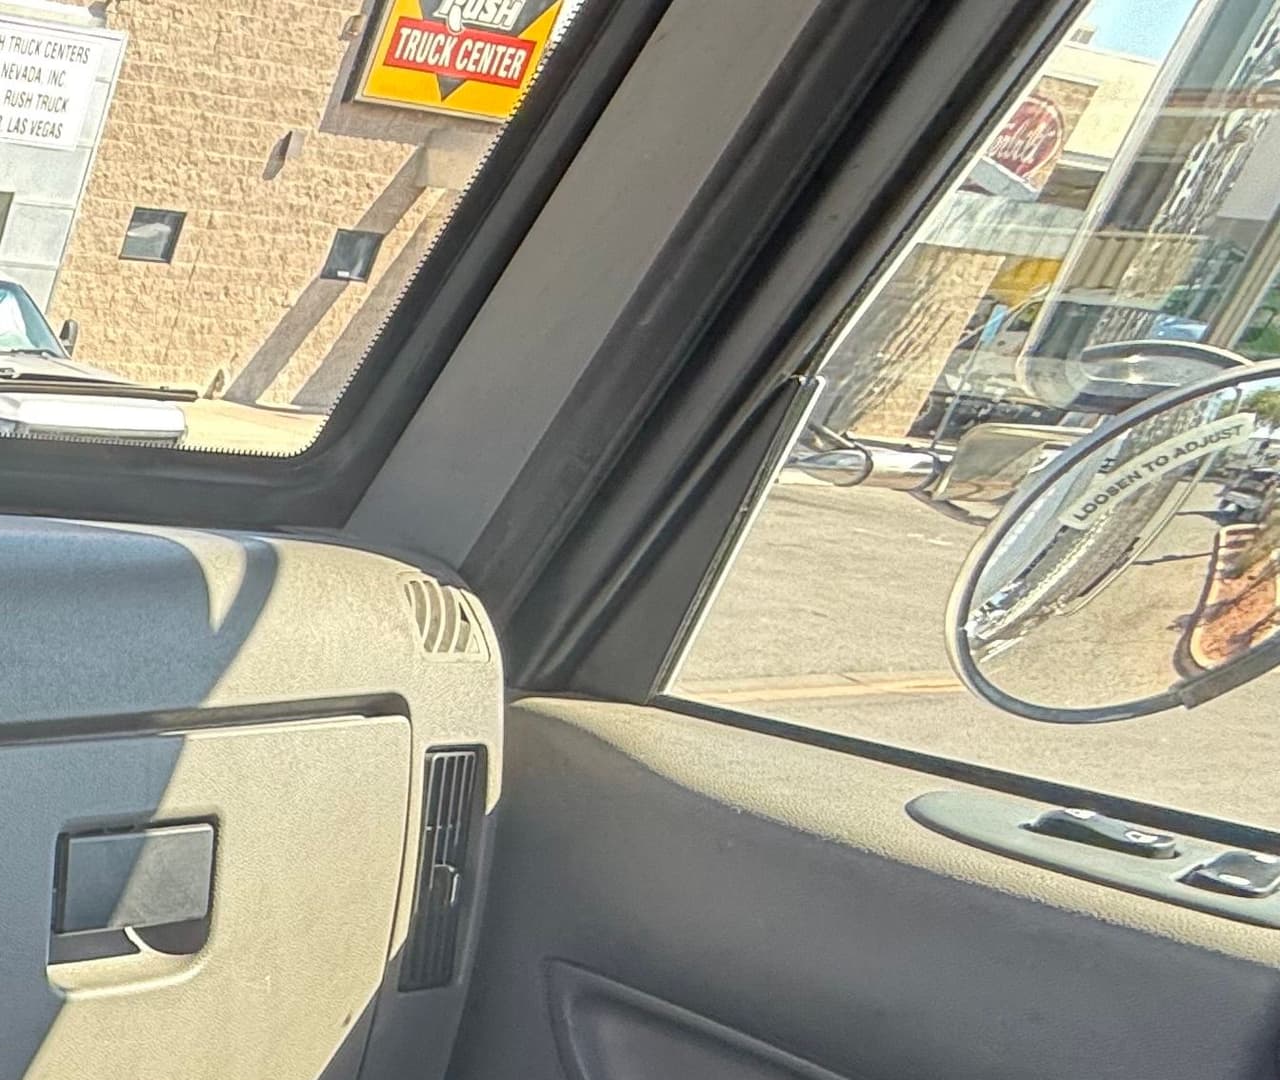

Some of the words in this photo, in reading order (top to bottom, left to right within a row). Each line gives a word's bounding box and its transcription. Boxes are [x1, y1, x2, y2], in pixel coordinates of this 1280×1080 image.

[9, 36, 42, 57] TRUCK
[44, 41, 90, 64] CENTERS
[394, 27, 458, 67] TRUCK
[455, 38, 527, 80] CENTER
[4, 89, 34, 109] RUSH
[35, 93, 69, 113] TRUCK
[7, 117, 28, 135] LAS
[30, 120, 63, 139] VEGAS
[1073, 470, 1143, 521] LOOSEN
[1142, 455, 1169, 473] TO
[1172, 424, 1244, 459] ADJUST
